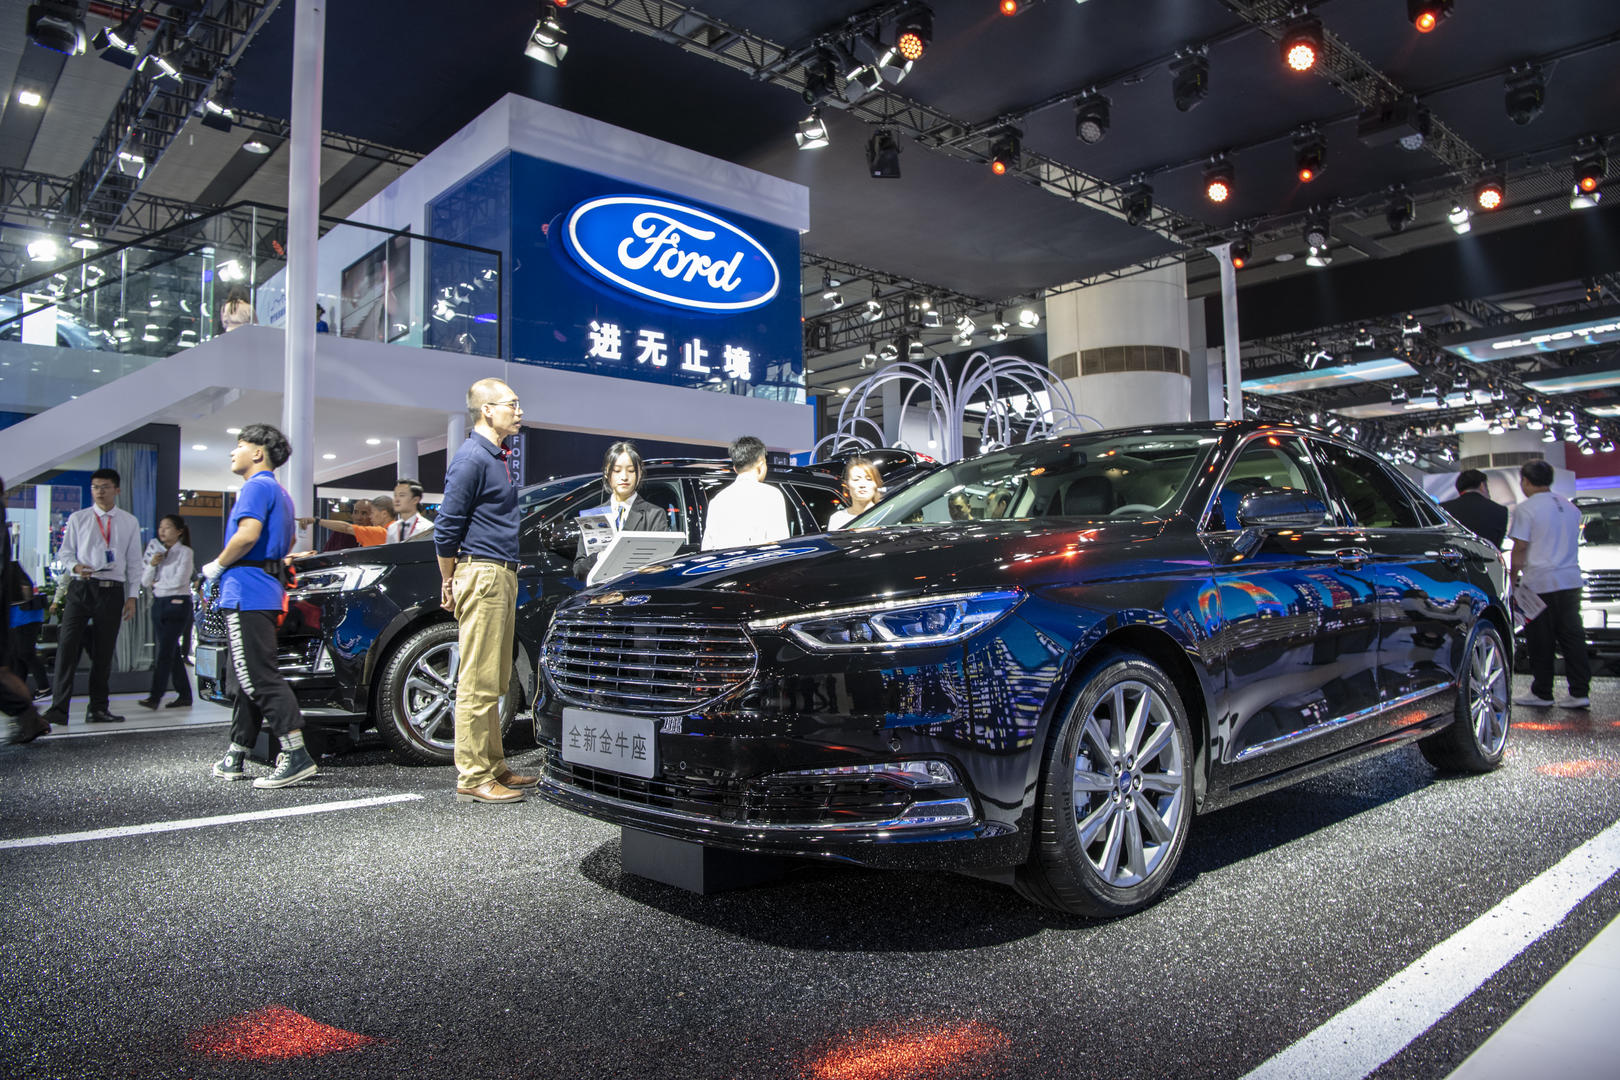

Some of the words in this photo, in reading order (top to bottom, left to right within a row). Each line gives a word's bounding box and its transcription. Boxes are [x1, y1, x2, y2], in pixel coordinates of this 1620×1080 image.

[618, 212, 744, 292] Ford
[589, 321, 751, 380] 进无止境
[568, 725, 647, 761] 全新金牛座
